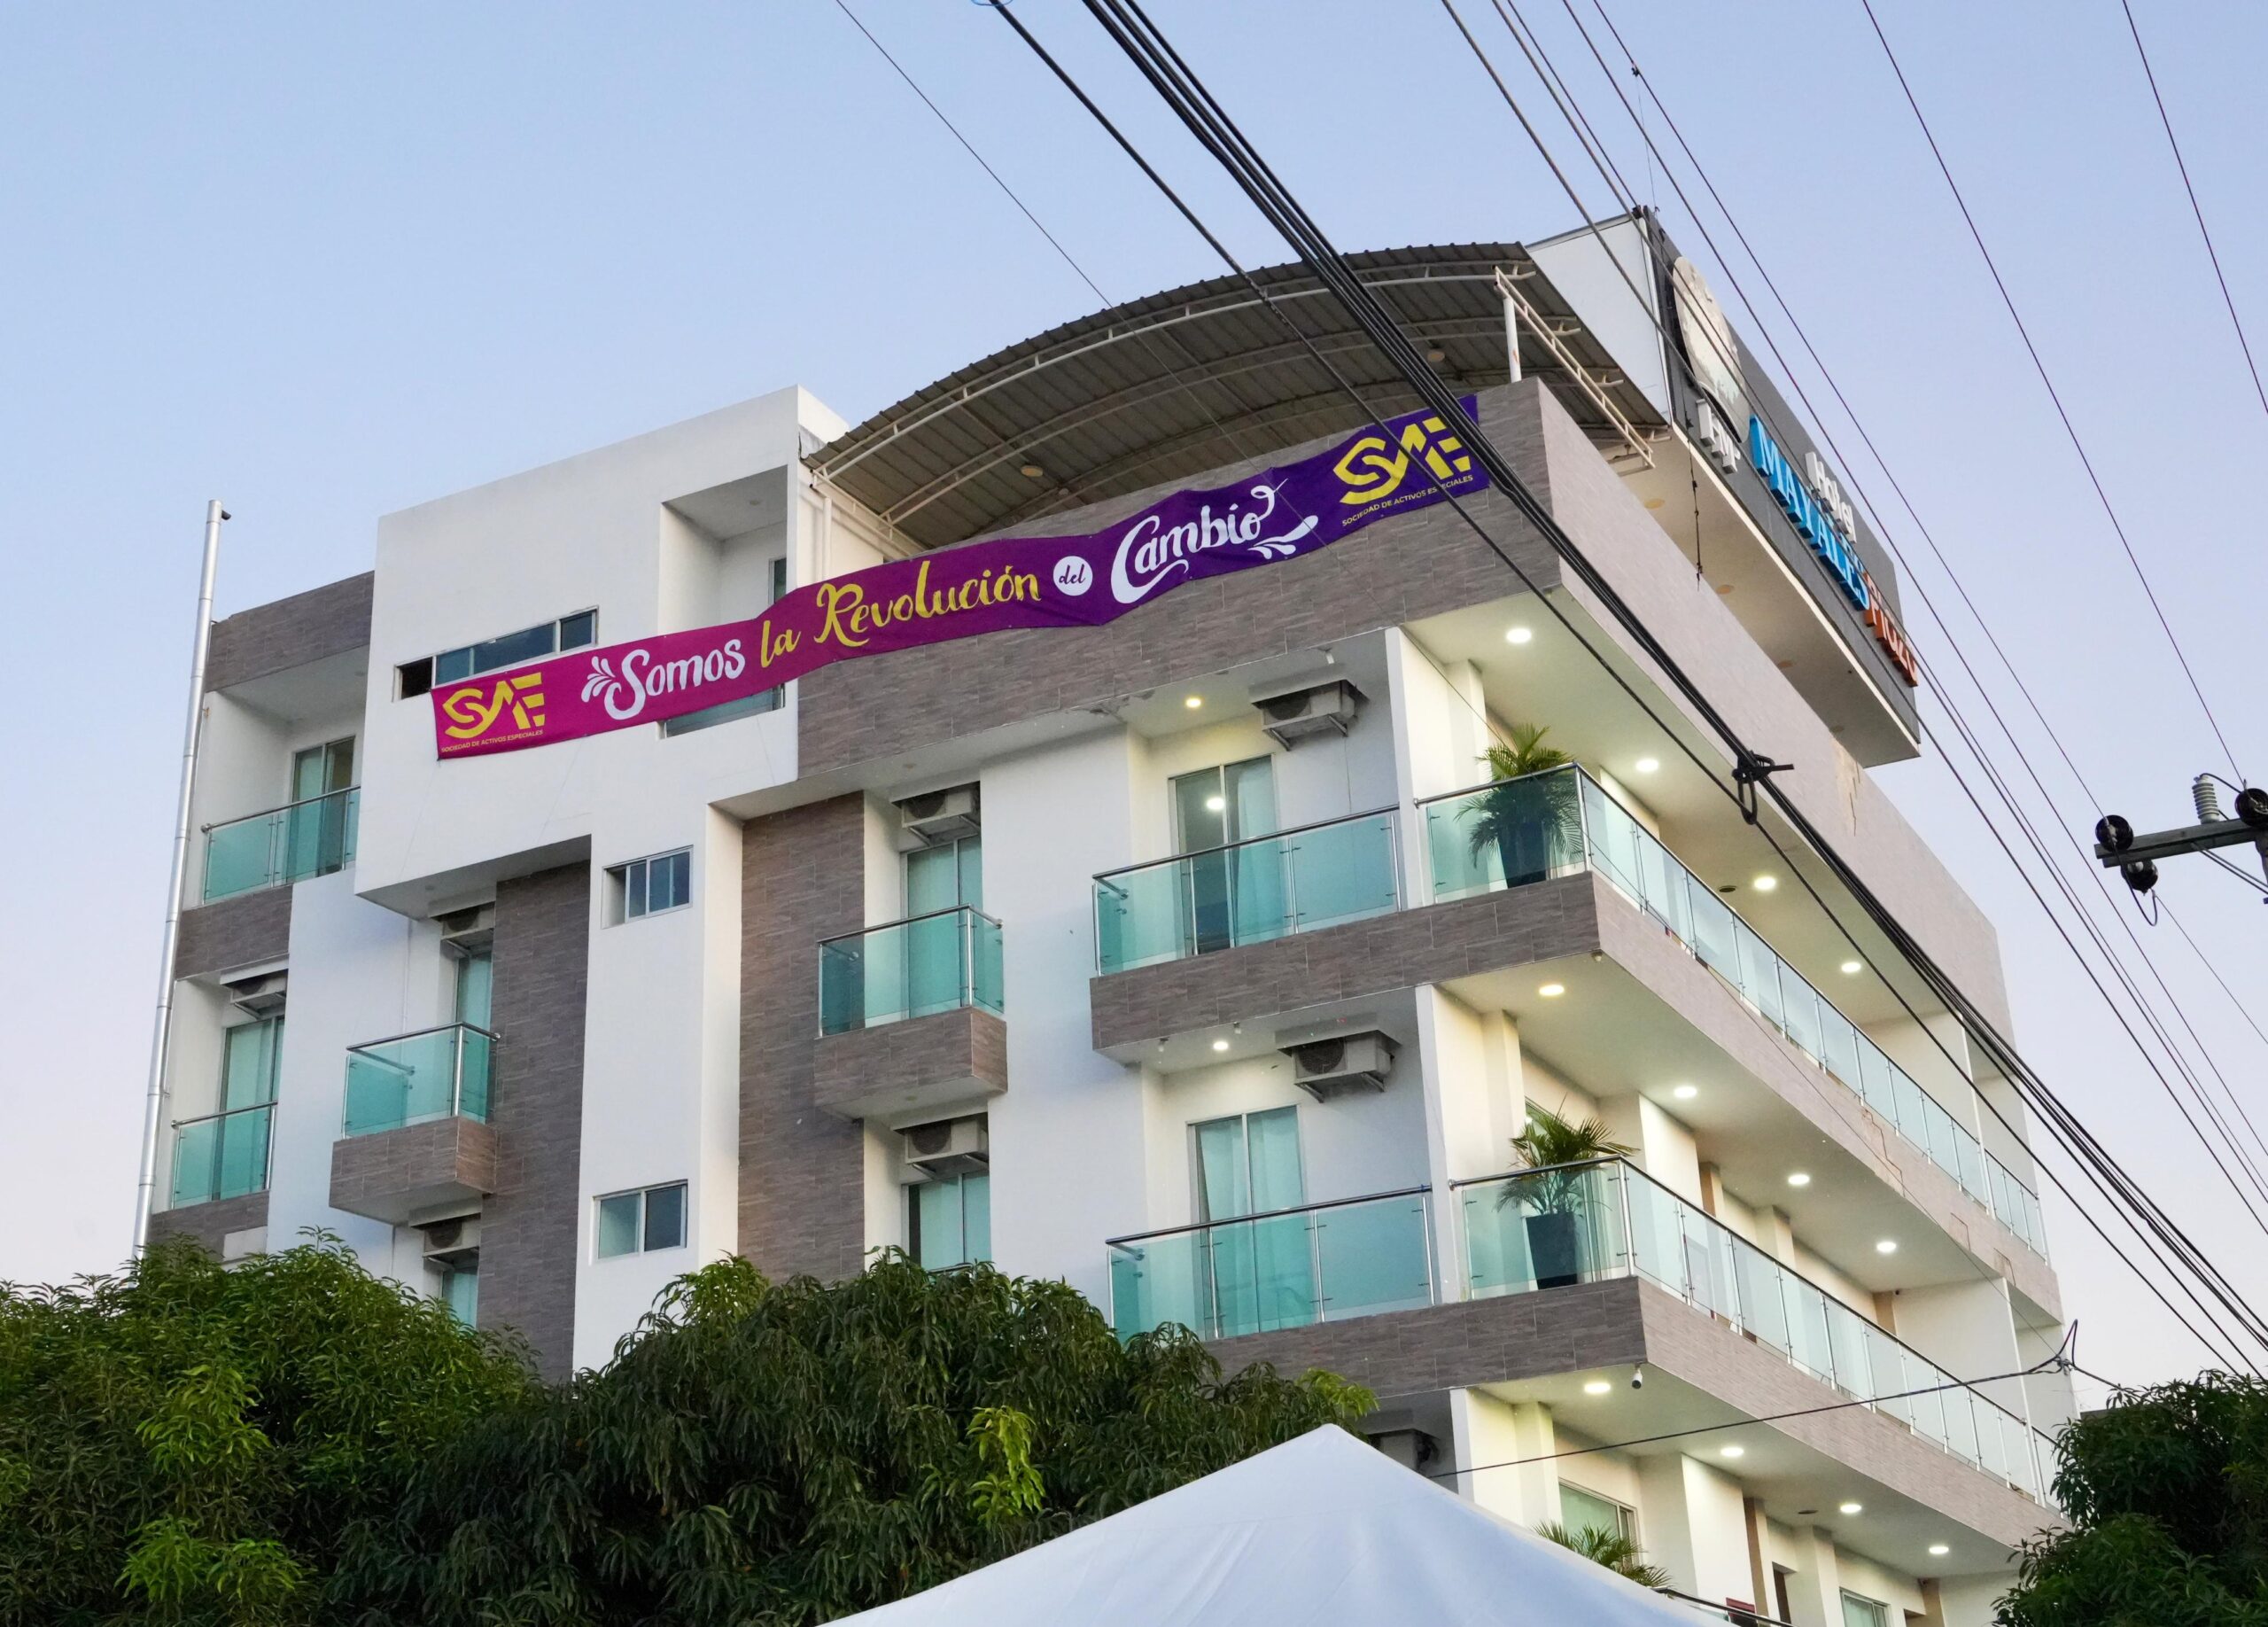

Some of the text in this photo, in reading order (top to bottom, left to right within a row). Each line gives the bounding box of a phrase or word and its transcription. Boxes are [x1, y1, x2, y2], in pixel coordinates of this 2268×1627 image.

[1342, 475, 1473, 526] SOCIEDAD DE ACTIVOS ESECIALES
[1749, 414, 1870, 611] MAYALES
[1806, 451, 1857, 543] Hotel
[603, 483, 1279, 720] Somos la Revolución del Cambio
[441, 742, 471, 753] SOCIEDAD
[481, 736, 506, 746] ACTIVOS
[507, 729, 543, 741] ESPECIALES
[442, 672, 546, 739] SAE
